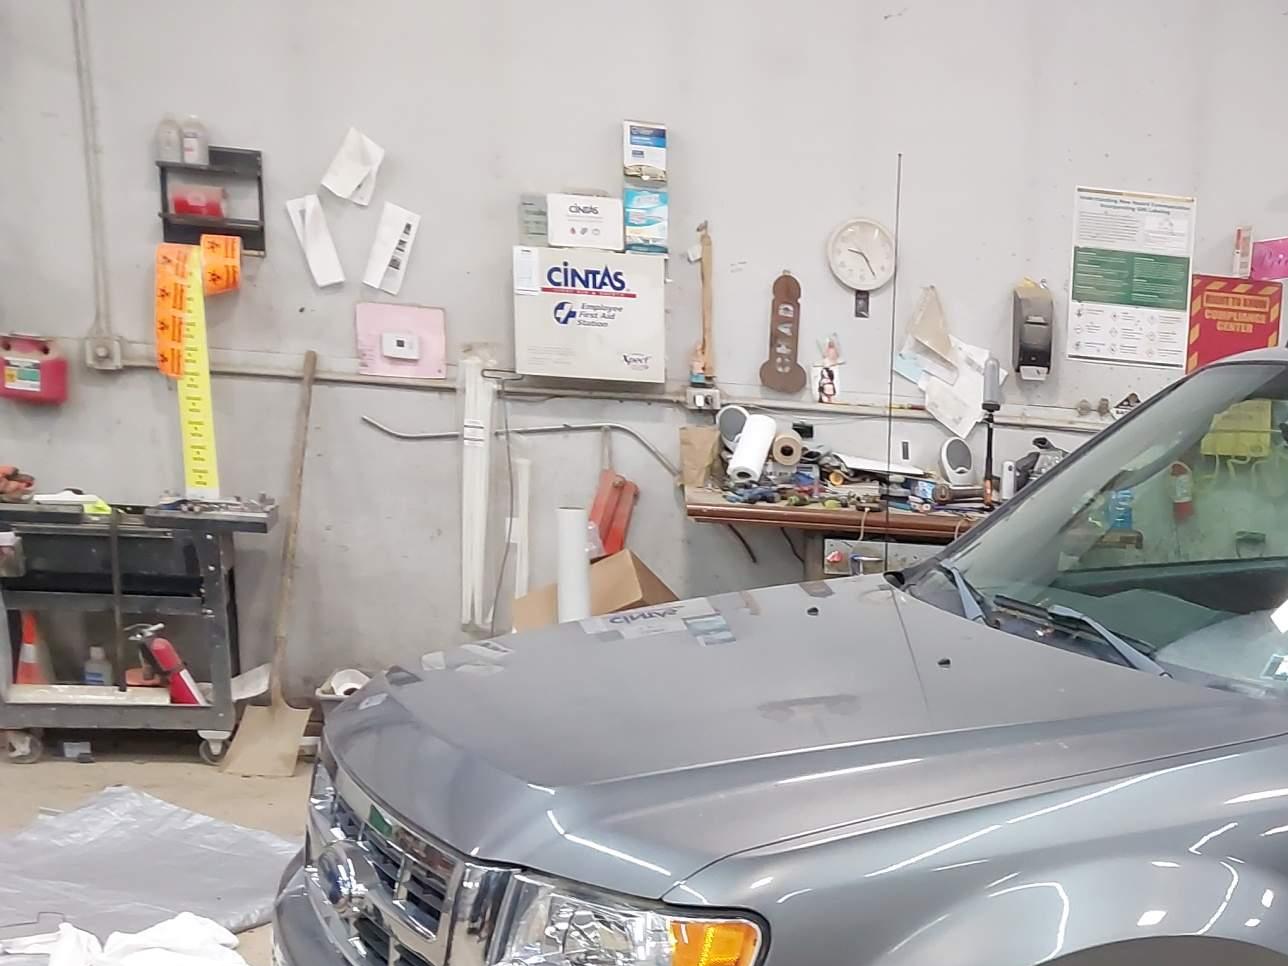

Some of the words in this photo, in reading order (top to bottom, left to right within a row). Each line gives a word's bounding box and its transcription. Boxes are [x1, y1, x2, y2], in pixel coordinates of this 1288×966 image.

[547, 261, 626, 291] CINTAS
[581, 303, 624, 313] Employee
[579, 311, 599, 319] First
[600, 312, 616, 320] Aid
[576, 319, 609, 328] Station
